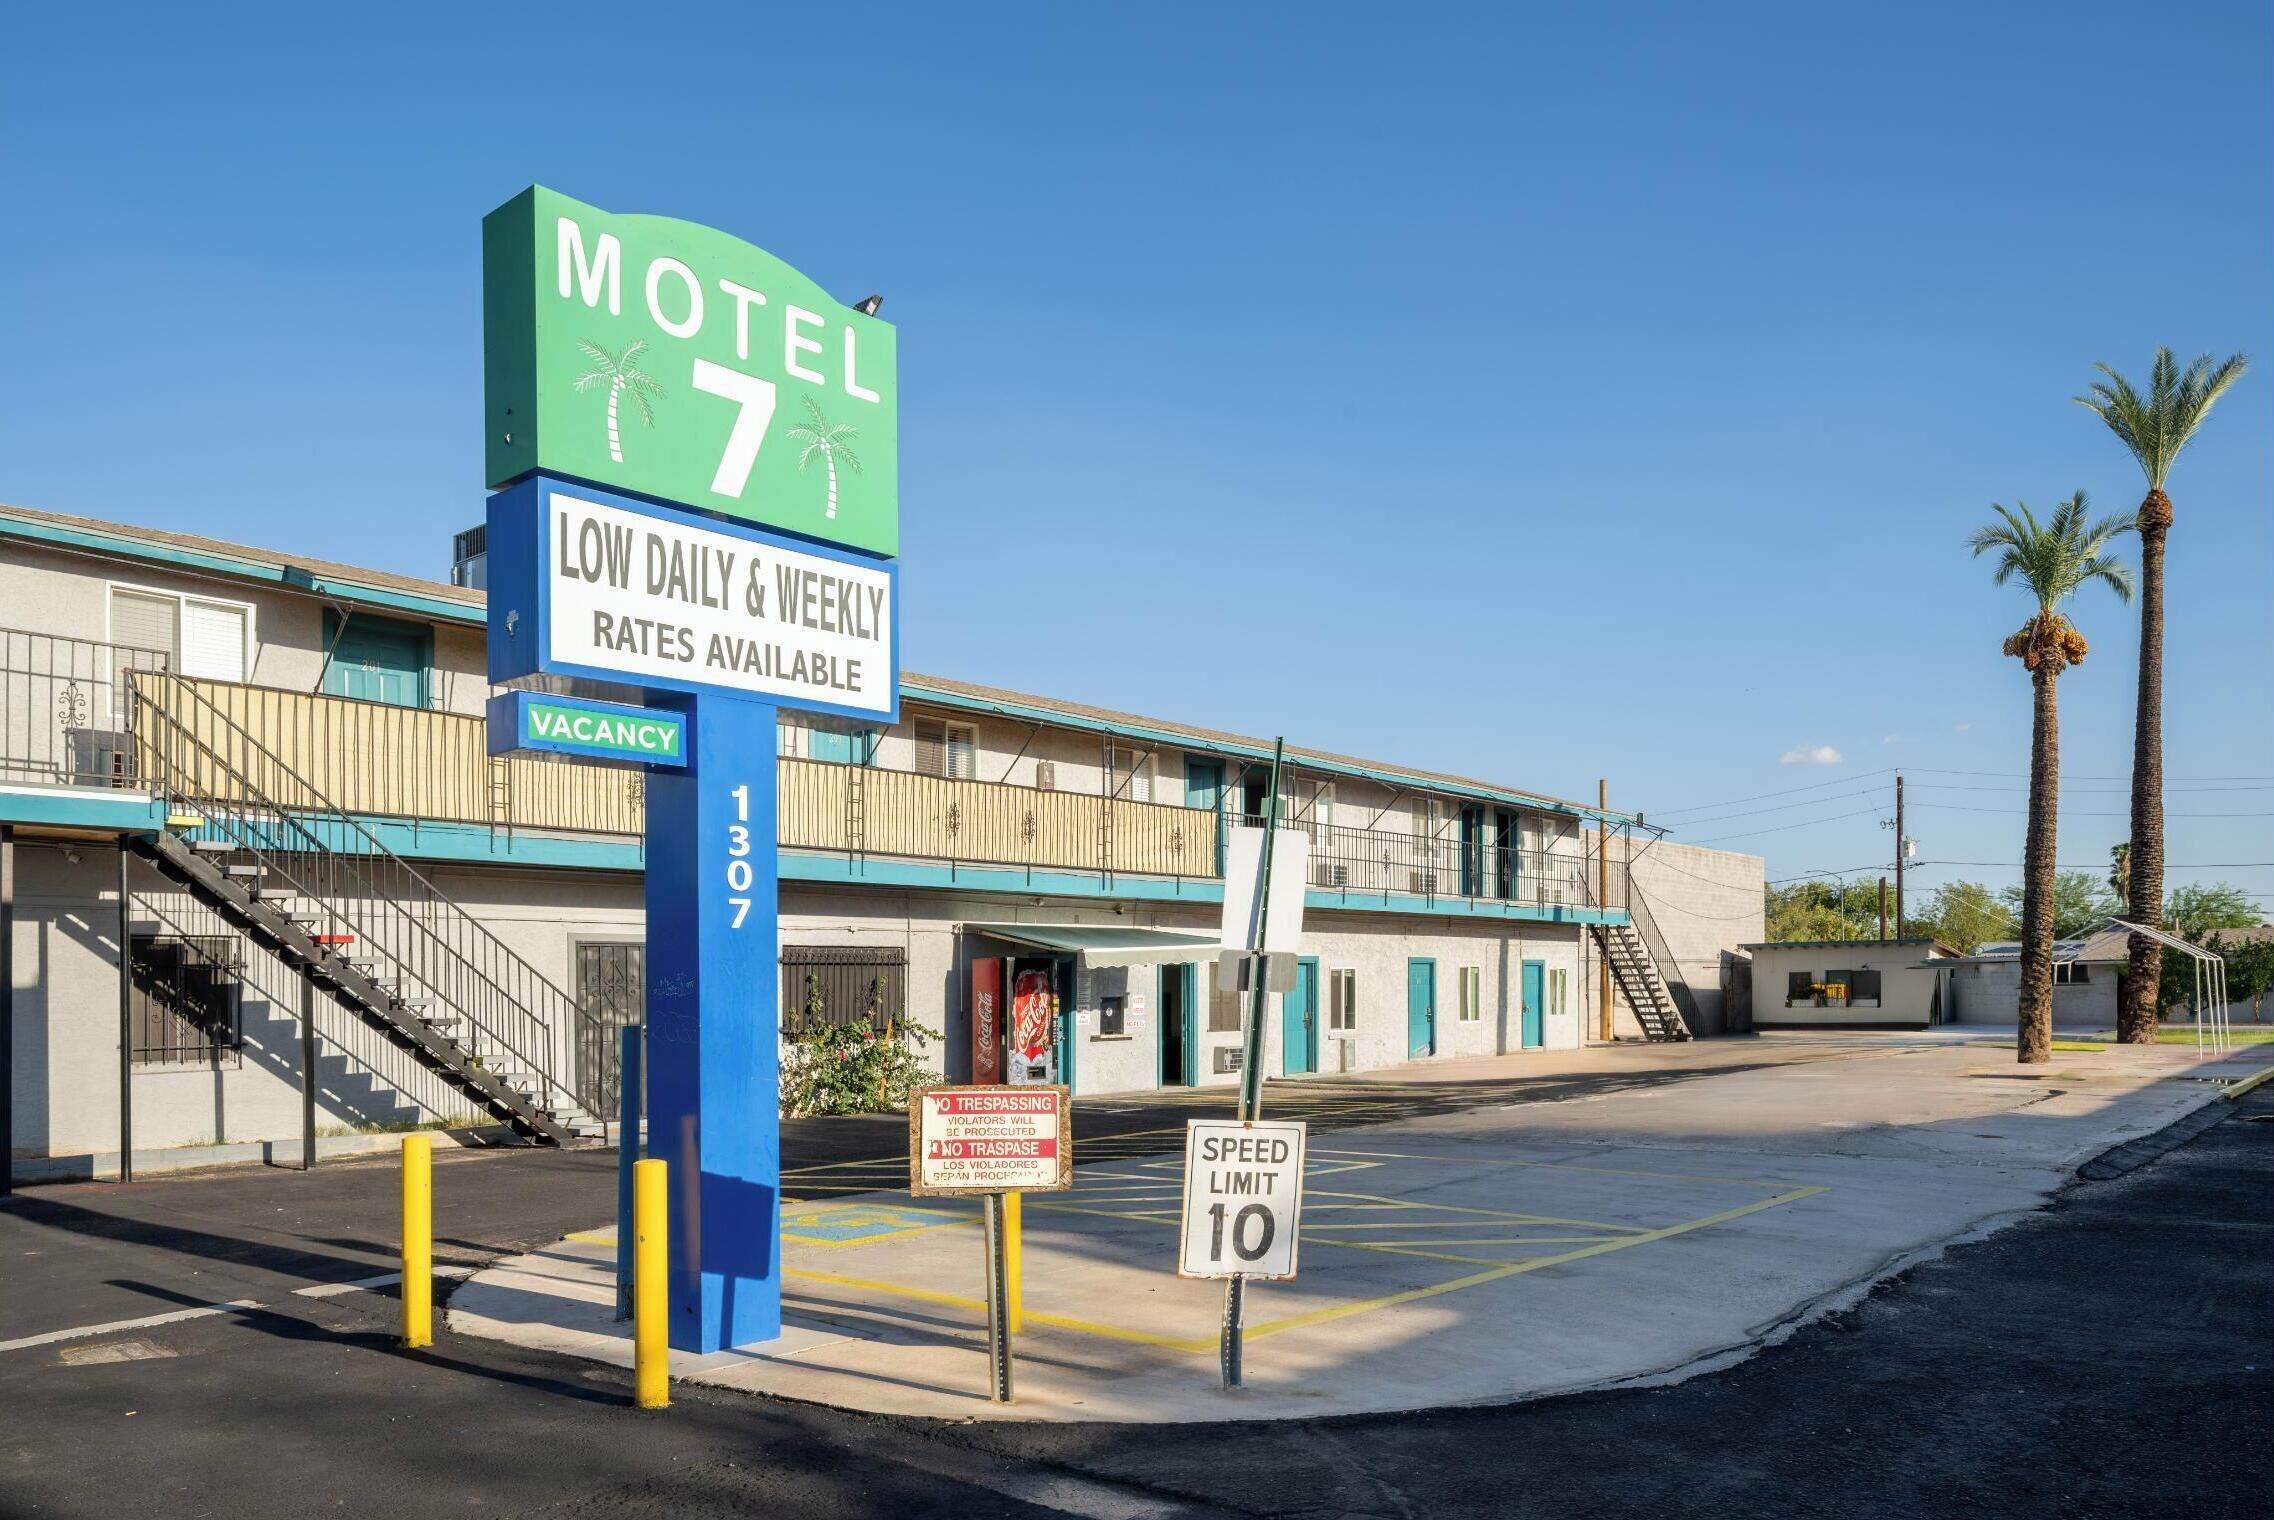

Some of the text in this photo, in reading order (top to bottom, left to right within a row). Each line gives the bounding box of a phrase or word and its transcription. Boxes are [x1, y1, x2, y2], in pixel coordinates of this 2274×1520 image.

[557, 216, 880, 404] MOTEL
[692, 357, 776, 499] 7
[560, 511, 884, 642] LOW DAILY & WEEKLY
[594, 610, 862, 693] RATES AVAILABLE
[530, 710, 676, 751] VACANCY
[727, 784, 753, 929] 1307
[948, 1115, 1036, 1125] VIOLATORS WILL
[956, 1096, 1052, 1111] TRESPASSING
[941, 1141, 1040, 1157] NO TRASPASE
[946, 1127, 1036, 1137] BE PROSECUTED
[943, 1160, 1038, 1170] LOS VIOLADORES
[1202, 1137, 1289, 1164] SPEED
[1210, 1171, 1279, 1195] LIMIT
[1208, 1203, 1276, 1262] 10
